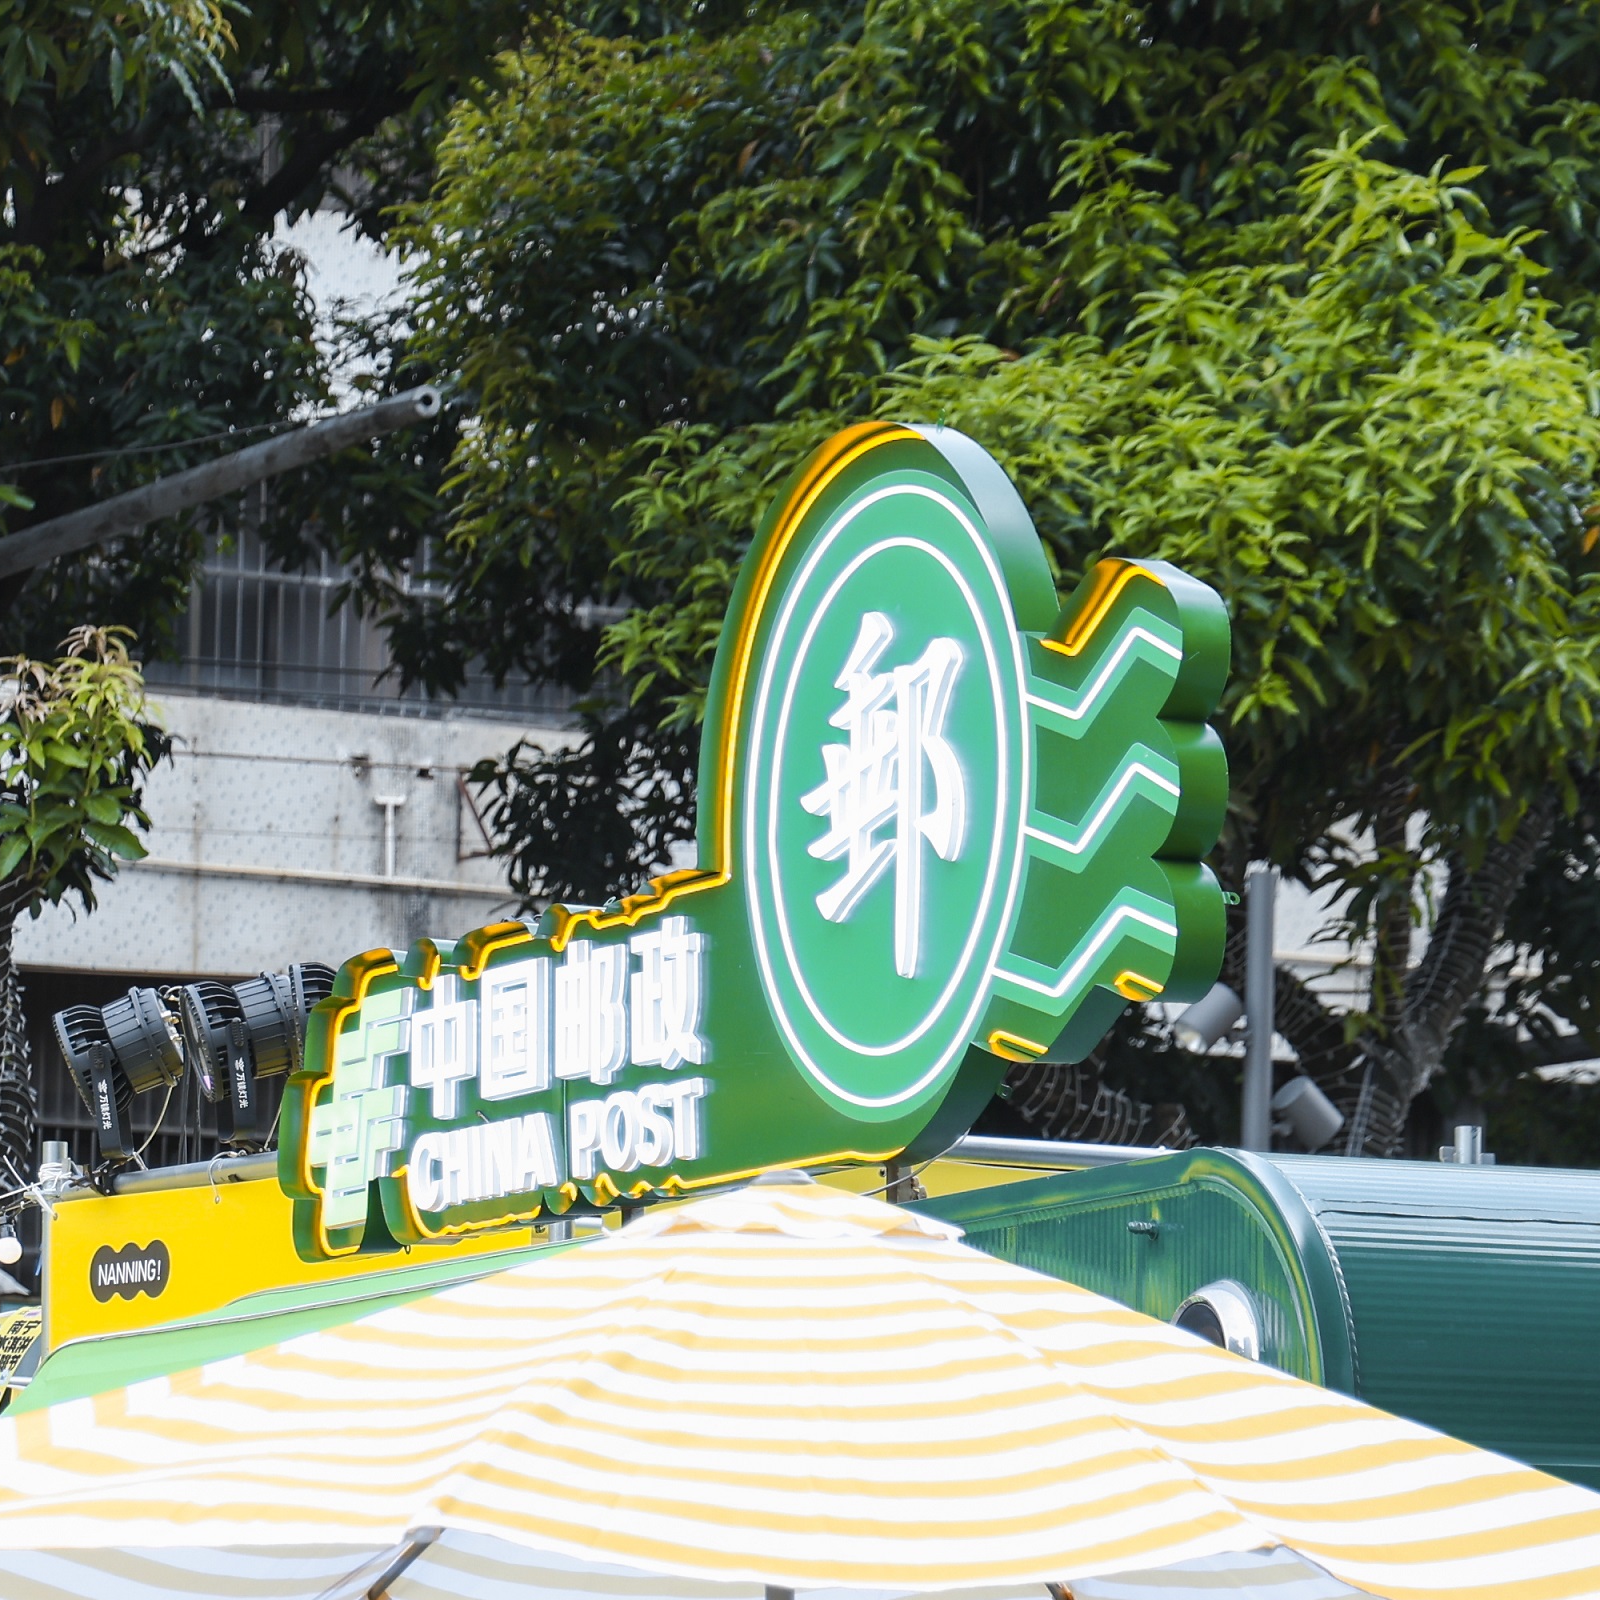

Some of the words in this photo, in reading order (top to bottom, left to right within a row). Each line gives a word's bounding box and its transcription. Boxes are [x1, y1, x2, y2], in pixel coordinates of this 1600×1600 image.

[800, 609, 965, 980] 郵
[410, 915, 708, 1120] 中国邮政
[409, 1112, 560, 1212] CHINA
[568, 1077, 710, 1180] POST
[7, 1320, 42, 1335] 南宁
[98, 1258, 162, 1287] NANNING!
